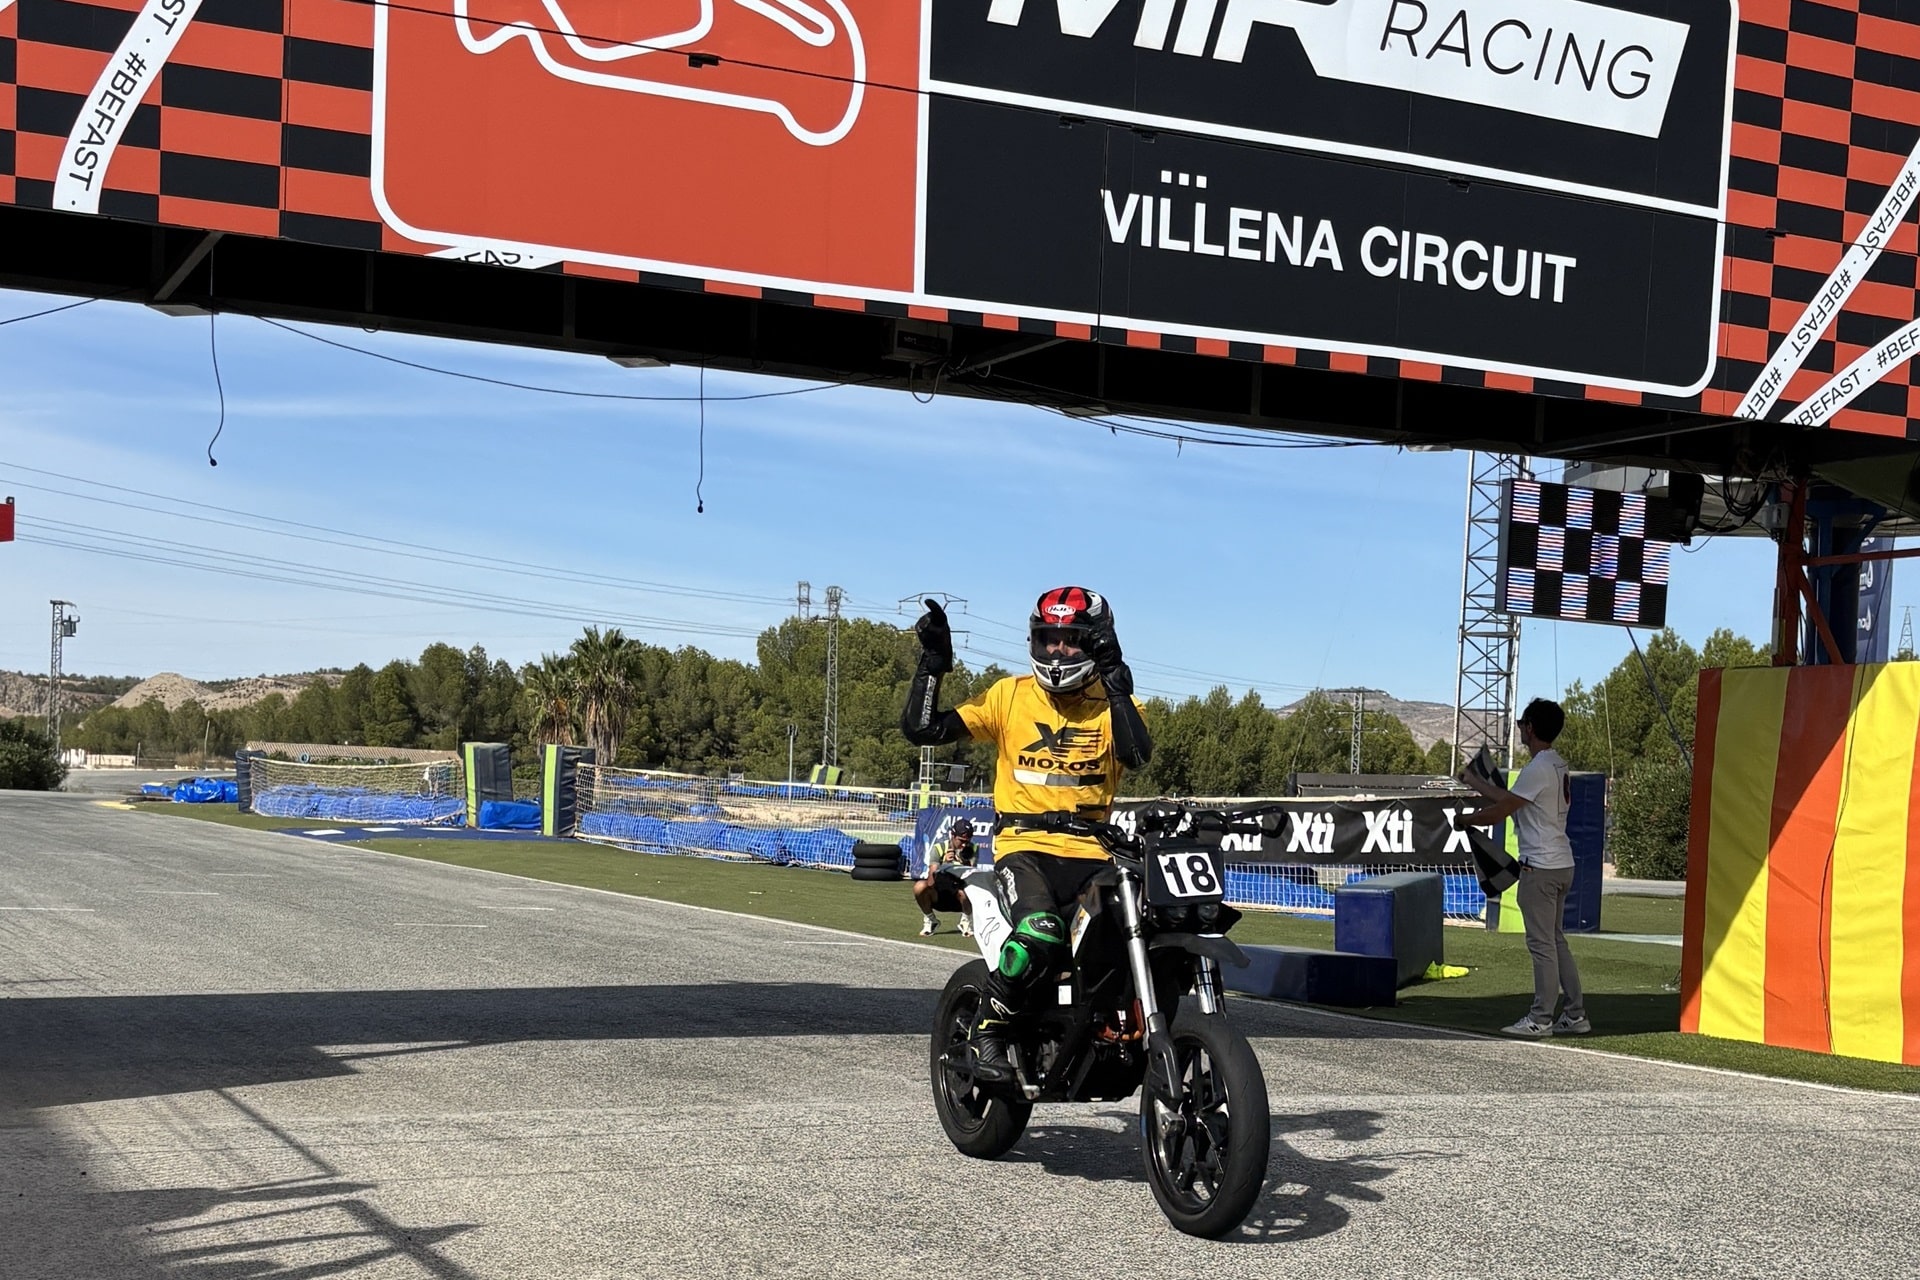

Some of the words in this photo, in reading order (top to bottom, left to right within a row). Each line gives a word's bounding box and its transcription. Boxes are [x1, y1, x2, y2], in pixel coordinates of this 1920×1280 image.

[1380, 0, 1653, 99] RACING
[69, 52, 147, 191] #BEFAST
[1101, 184, 1344, 271] VILLENA
[1360, 225, 1577, 303] CIRCUIT
[1860, 170, 1917, 260] #BEFAST
[1791, 269, 1852, 358] #BEFAST
[1018, 755, 1100, 770] MOTOS
[1164, 855, 1216, 894] 18
[1286, 811, 1335, 854] Xti
[1360, 809, 1415, 853] Xti
